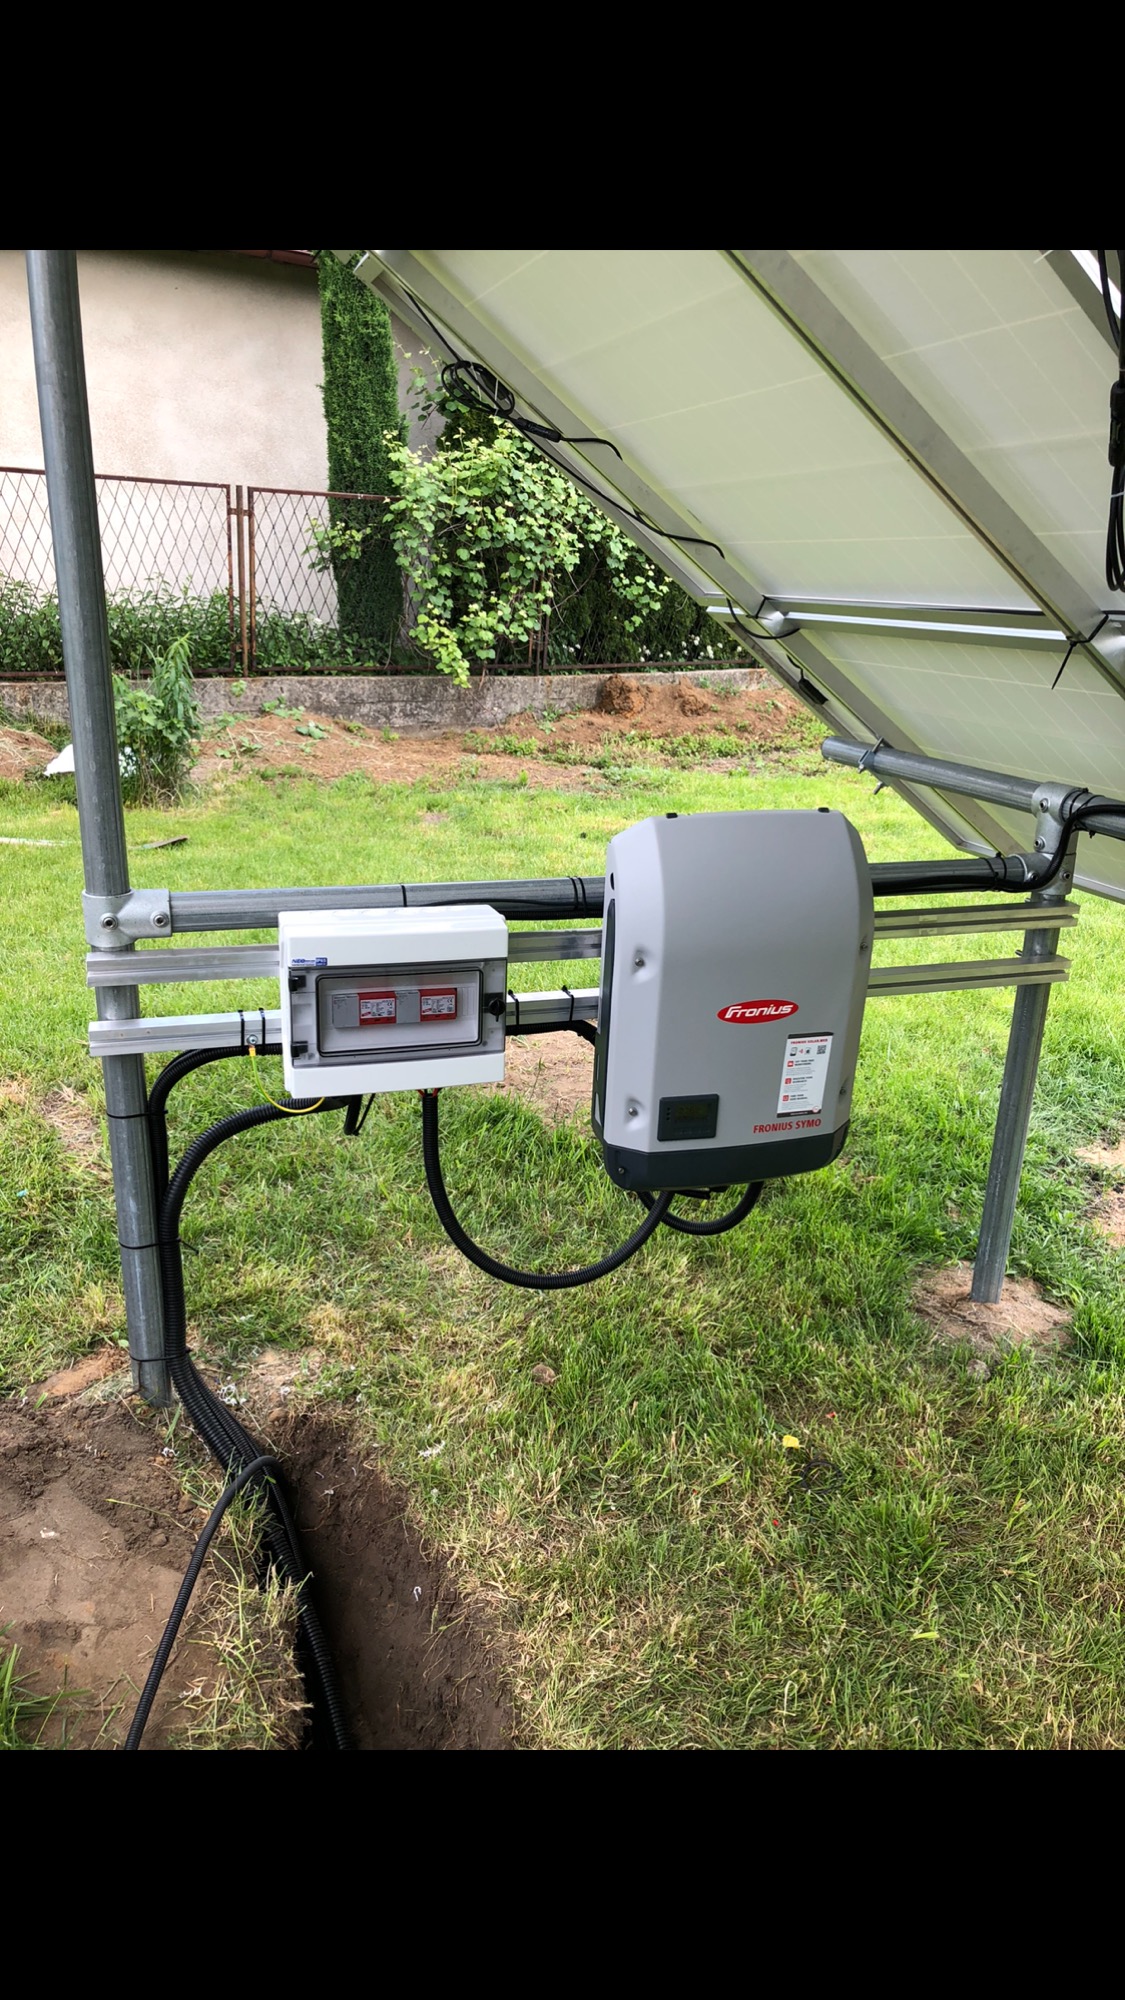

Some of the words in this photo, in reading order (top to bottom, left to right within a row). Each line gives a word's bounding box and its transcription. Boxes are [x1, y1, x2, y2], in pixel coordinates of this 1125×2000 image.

[724, 1004, 794, 1018] Fronius
[753, 1121, 793, 1134] FRONIUS
[795, 1118, 822, 1130] SYMO
